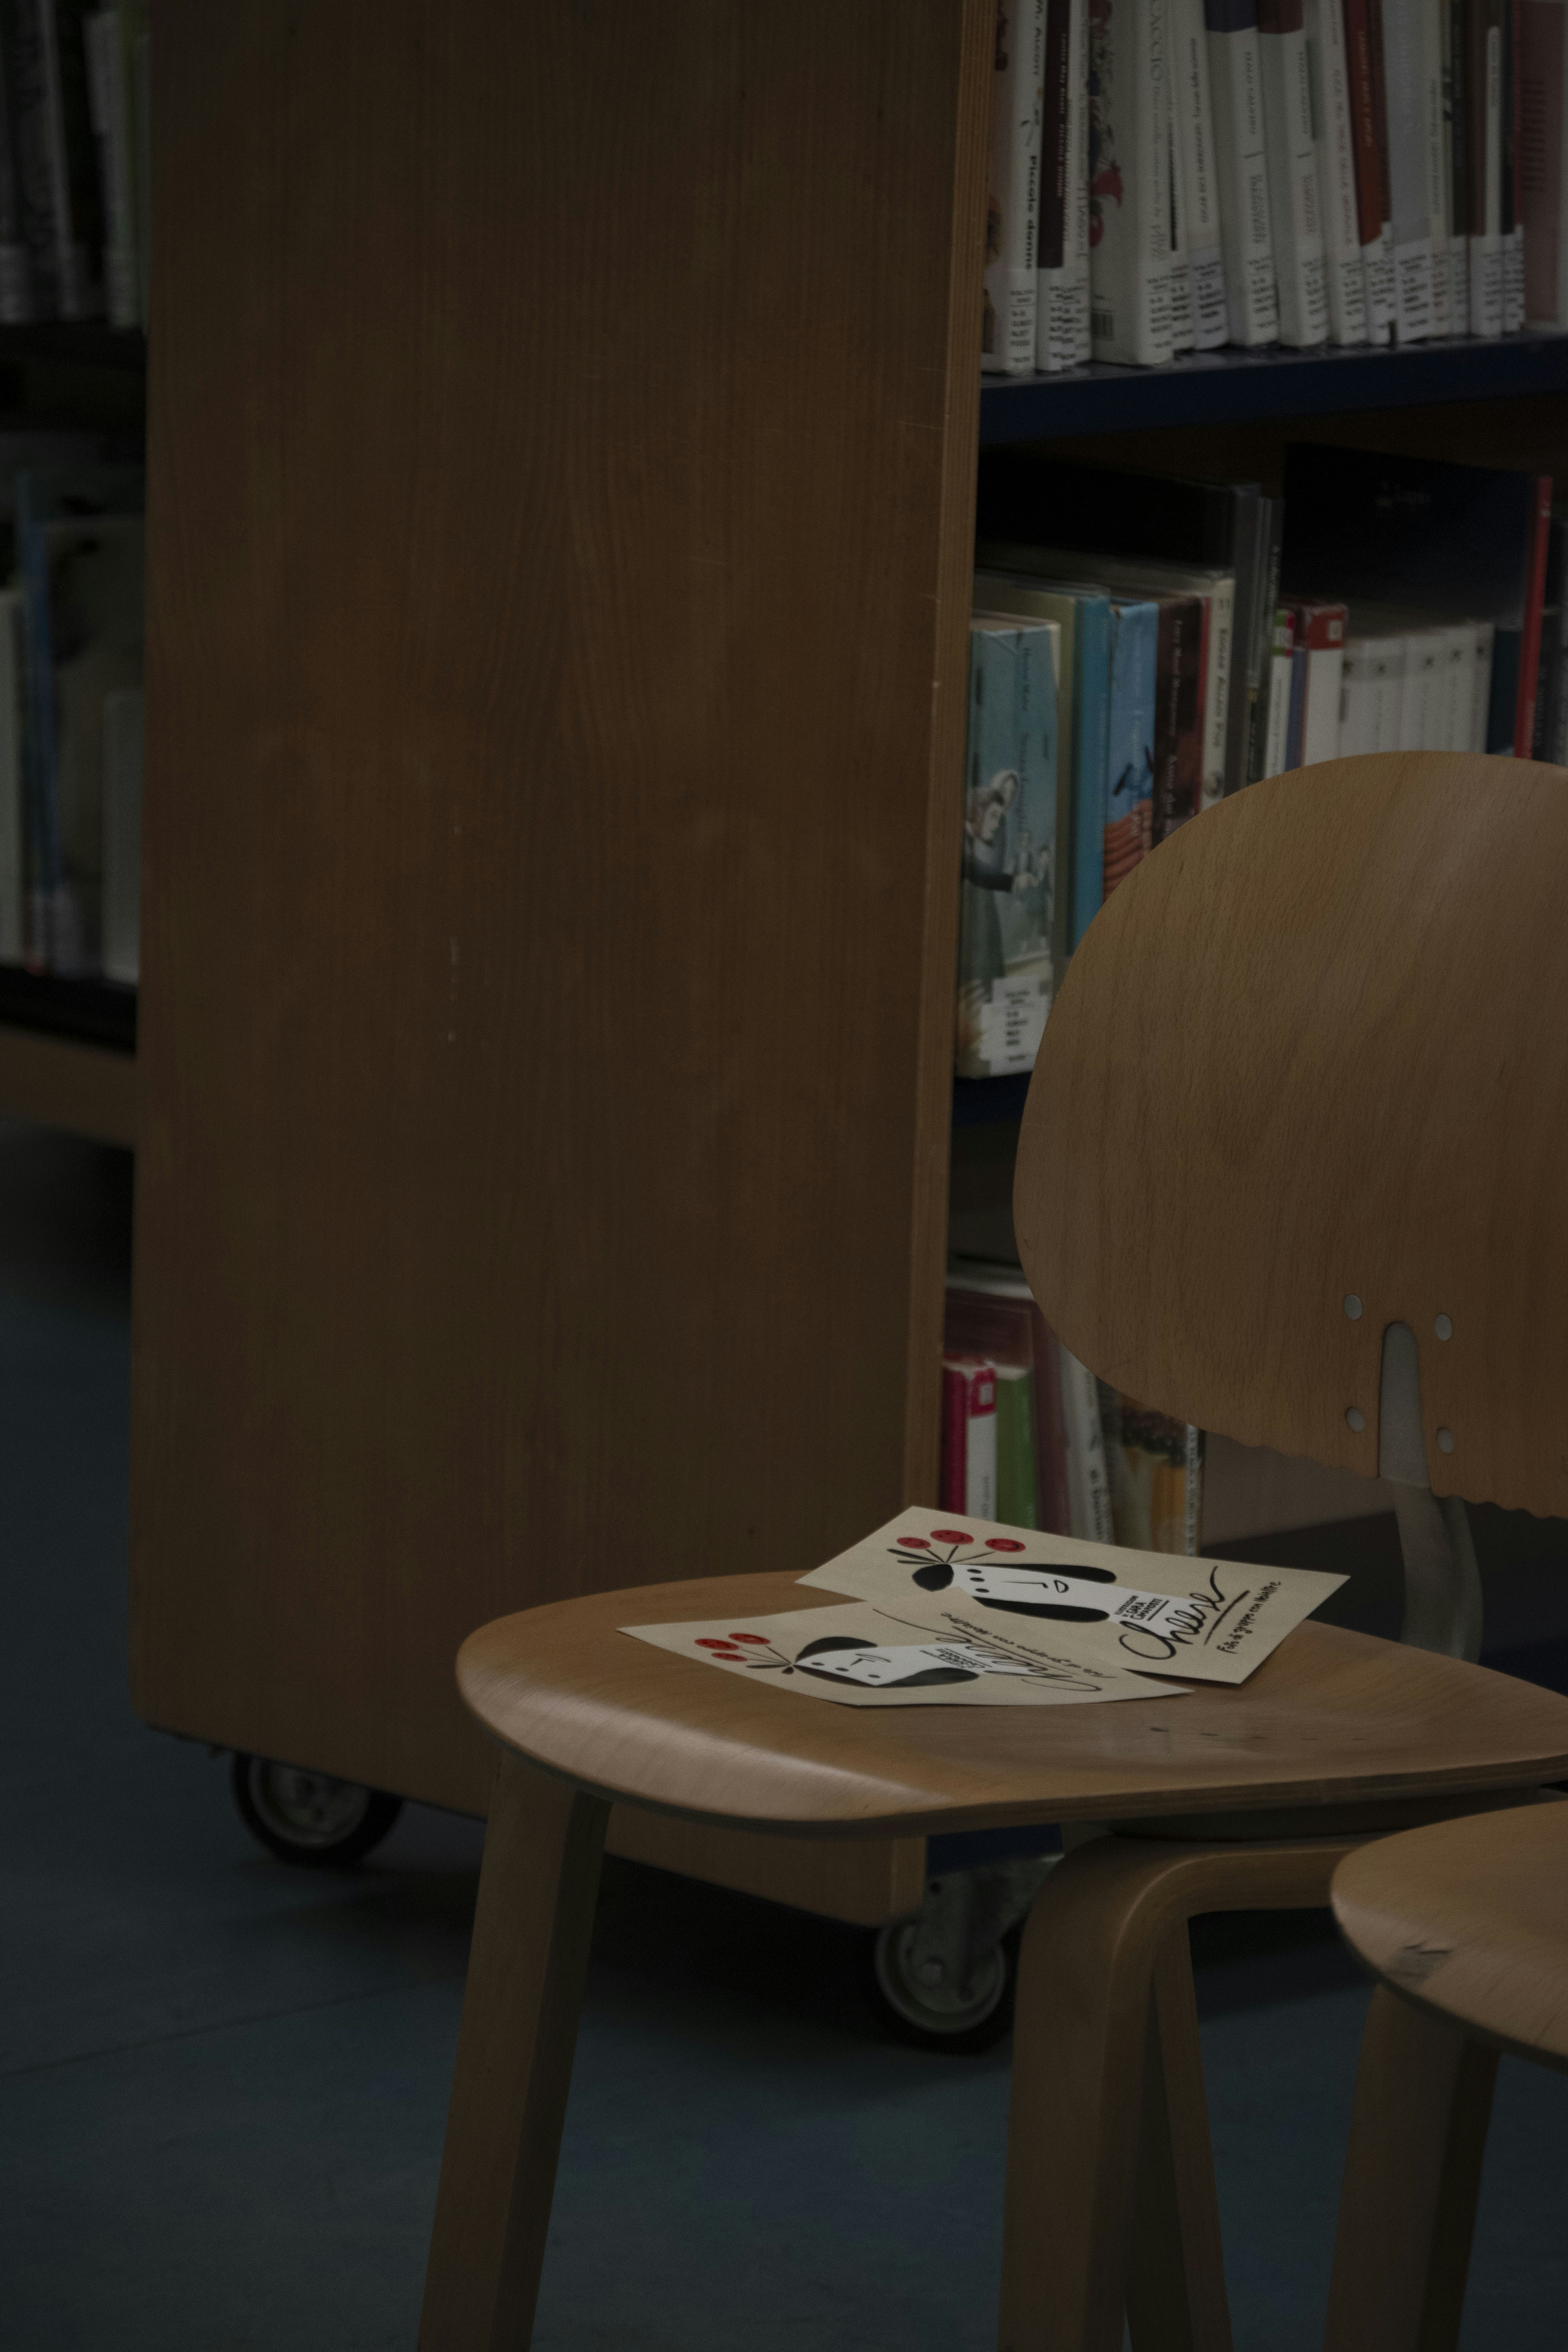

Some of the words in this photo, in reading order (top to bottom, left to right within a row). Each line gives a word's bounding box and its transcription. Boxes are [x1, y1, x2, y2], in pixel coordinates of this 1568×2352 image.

[1026, 154, 1037, 213] Piccole
[1119, 1566, 1225, 1660] Cheese
[1125, 1602, 1146, 1614] SARA
[1216, 1641, 1240, 1654] Foto
[1233, 1613, 1256, 1634] gruppo
[1249, 1604, 1263, 1612] con
